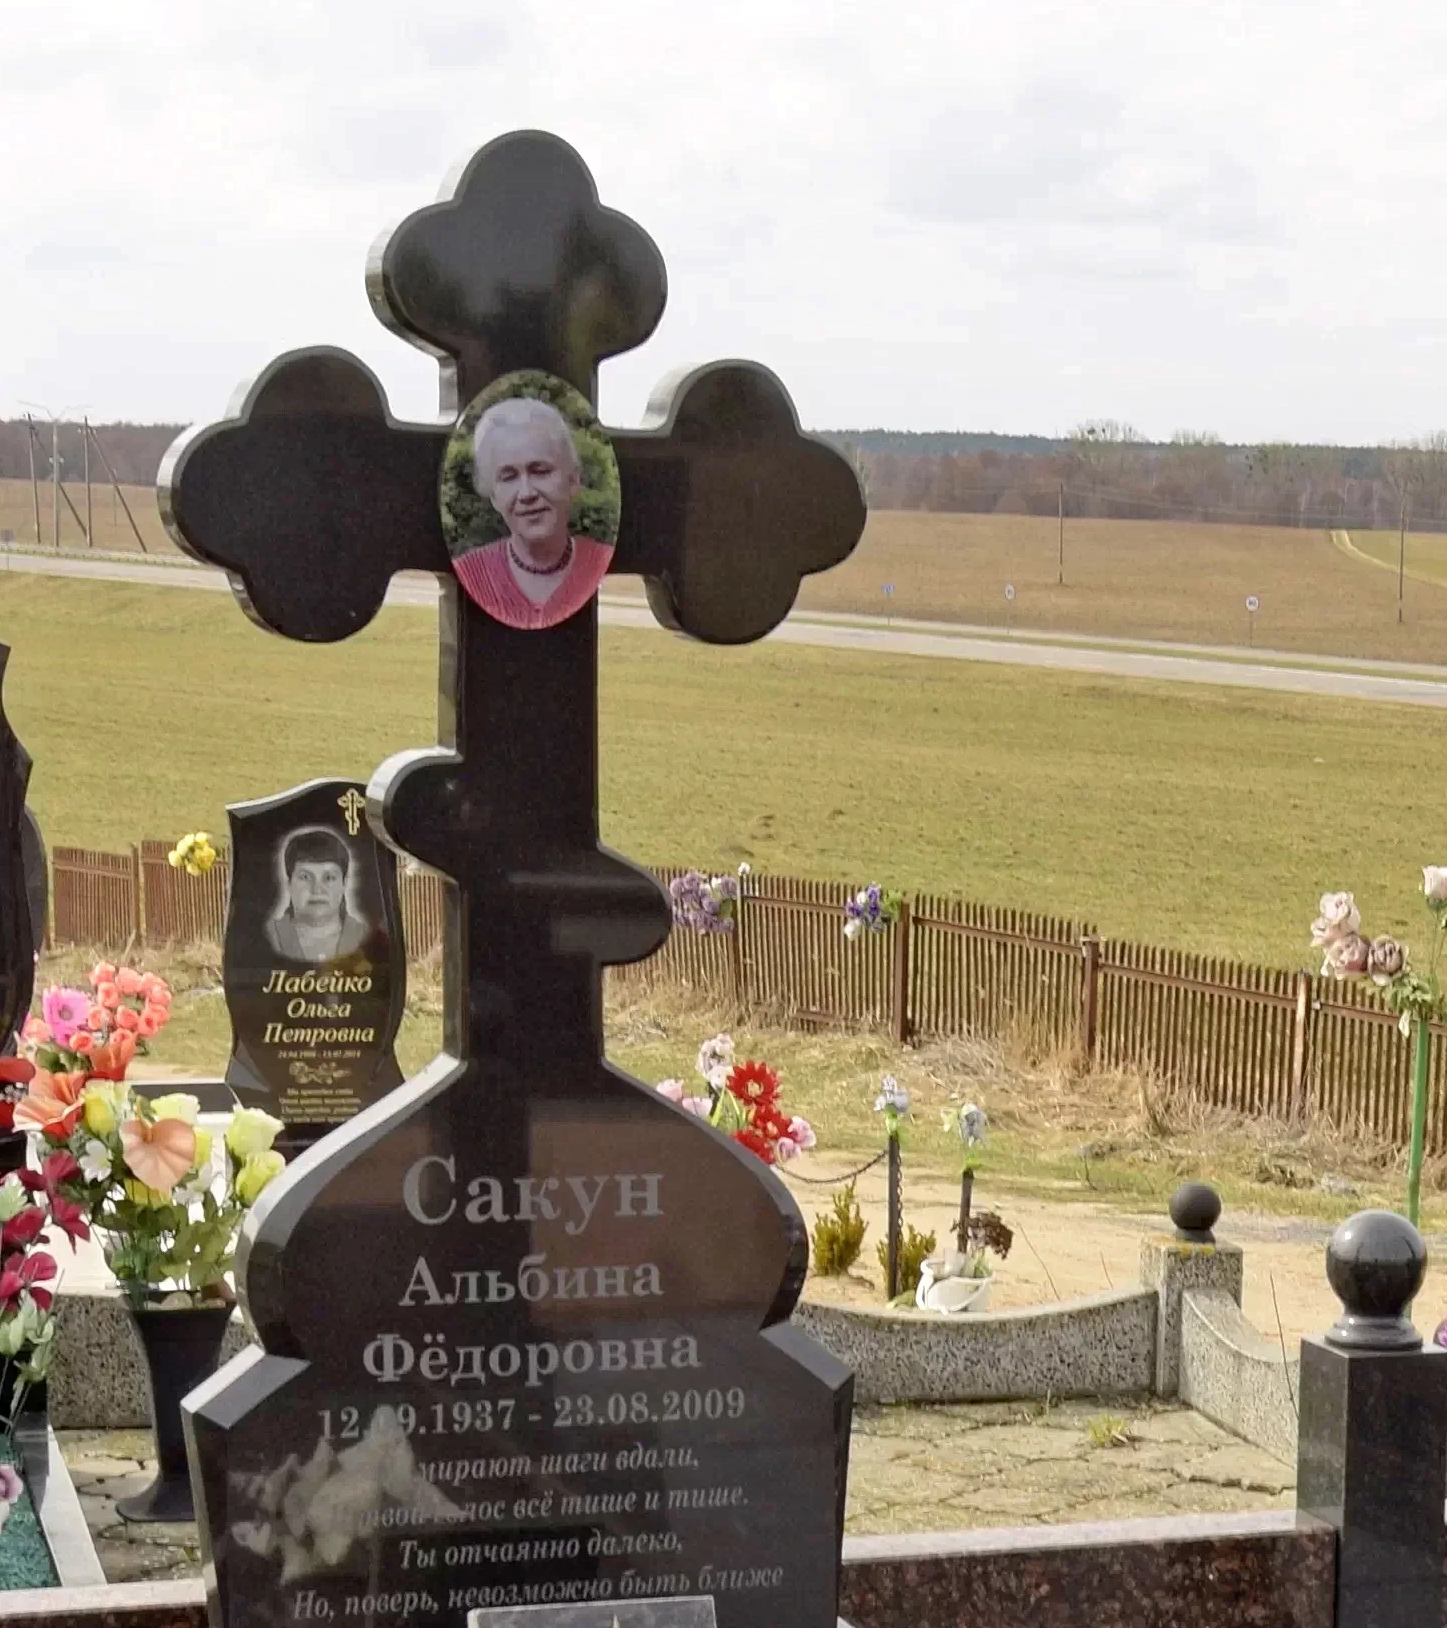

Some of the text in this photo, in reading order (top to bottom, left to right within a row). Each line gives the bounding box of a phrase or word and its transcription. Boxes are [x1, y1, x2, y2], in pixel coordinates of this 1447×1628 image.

[262, 969, 373, 996] Лабейко
[287, 998, 352, 1020] Ольга
[263, 1022, 375, 1048] Петровна
[402, 1154, 665, 1236] Сакун
[398, 1251, 665, 1307] Альбина
[362, 1333, 703, 1388] Фёдоровна
[553, 1384, 746, 1430] 23.08.2009
[540, 1451, 609, 1477] шаги
[615, 1442, 699, 1471] вдали,
[513, 1489, 553, 1519] всё
[561, 1489, 637, 1517] тише
[643, 1487, 662, 1511] и
[667, 1482, 749, 1511] тише.
[399, 1526, 684, 1570] Ты отчаянно далеко,
[292, 1564, 784, 1622] Но, поверь, невозможно быть ближе
